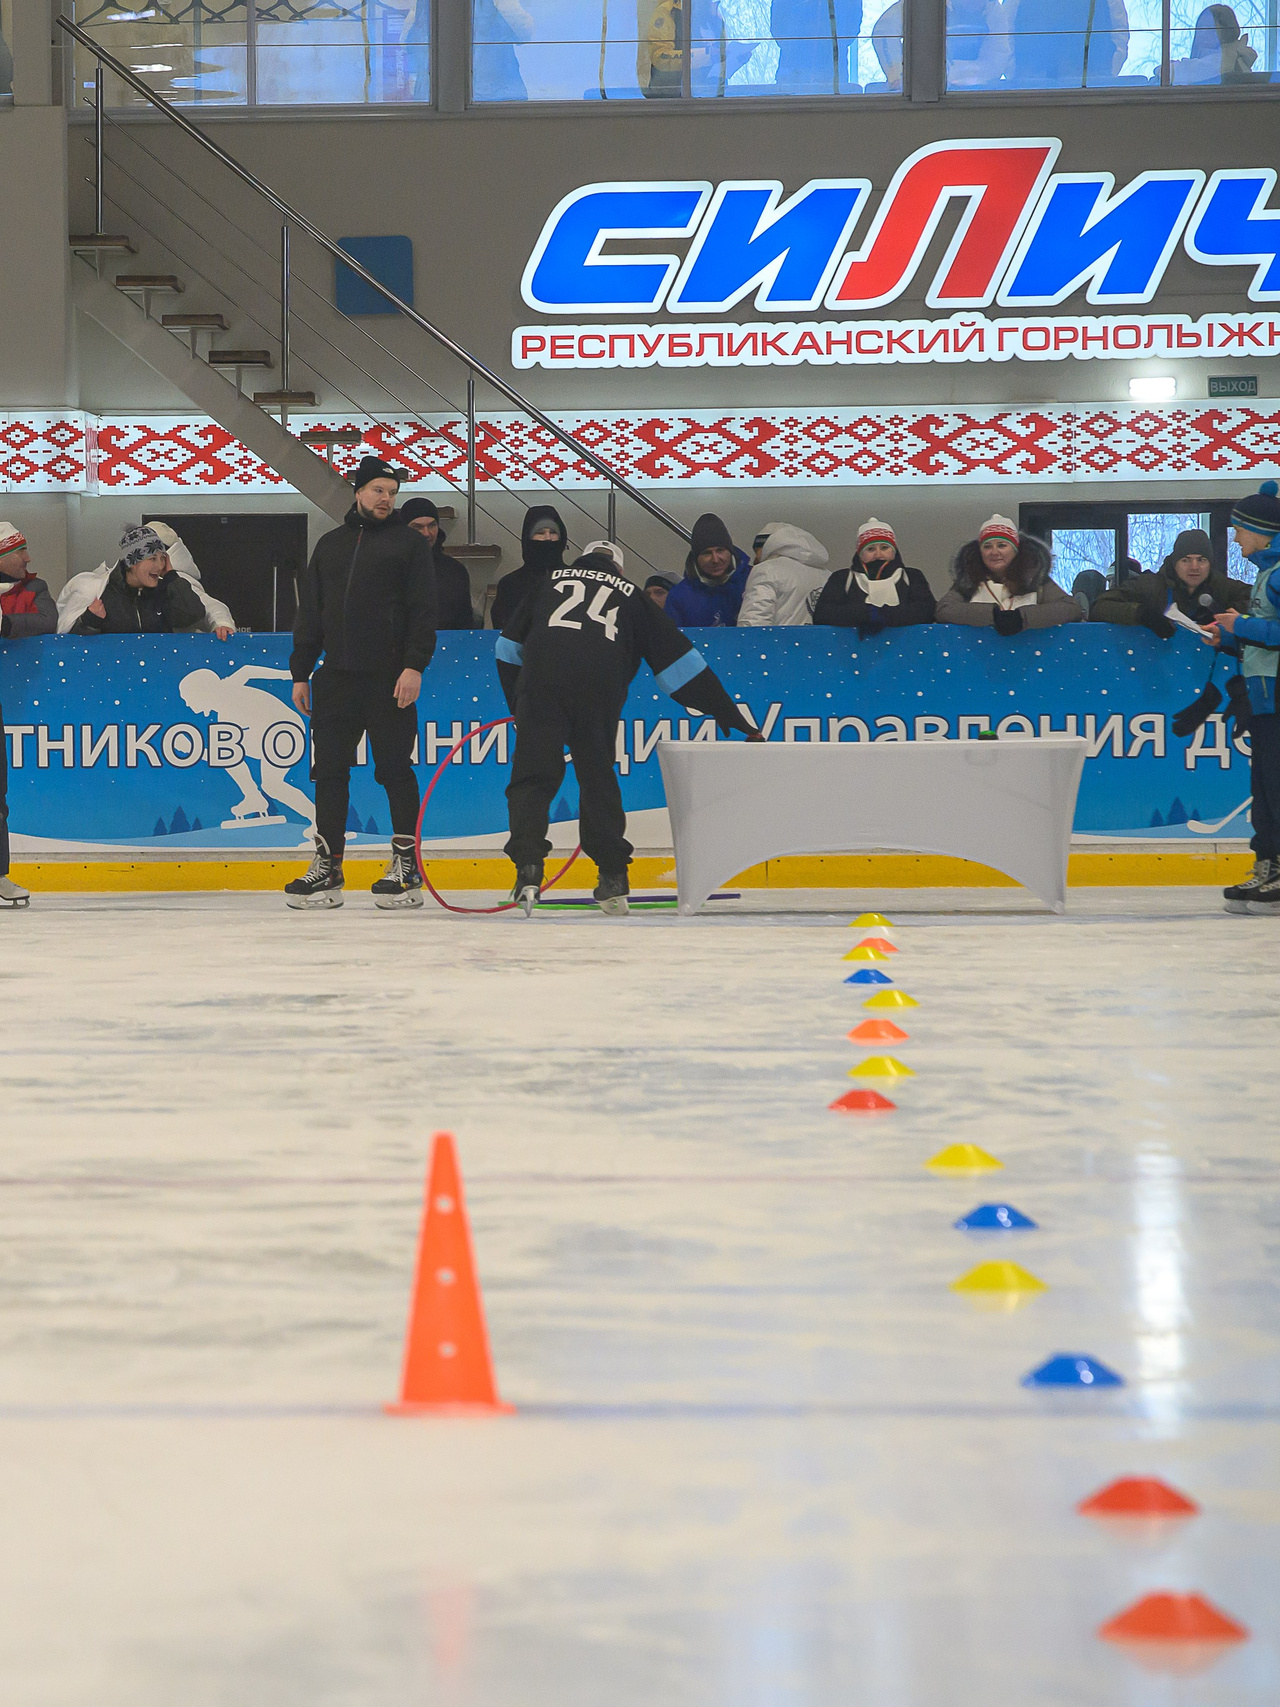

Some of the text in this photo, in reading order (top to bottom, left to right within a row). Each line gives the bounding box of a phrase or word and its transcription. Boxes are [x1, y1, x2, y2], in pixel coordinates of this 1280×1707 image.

[520, 321, 986, 360] РЕСПУБЛИКАНСКИЙ
[1210, 381, 1257, 393] ВЫХОД
[551, 569, 635, 597] DENISENKO
[548, 580, 620, 642] 24
